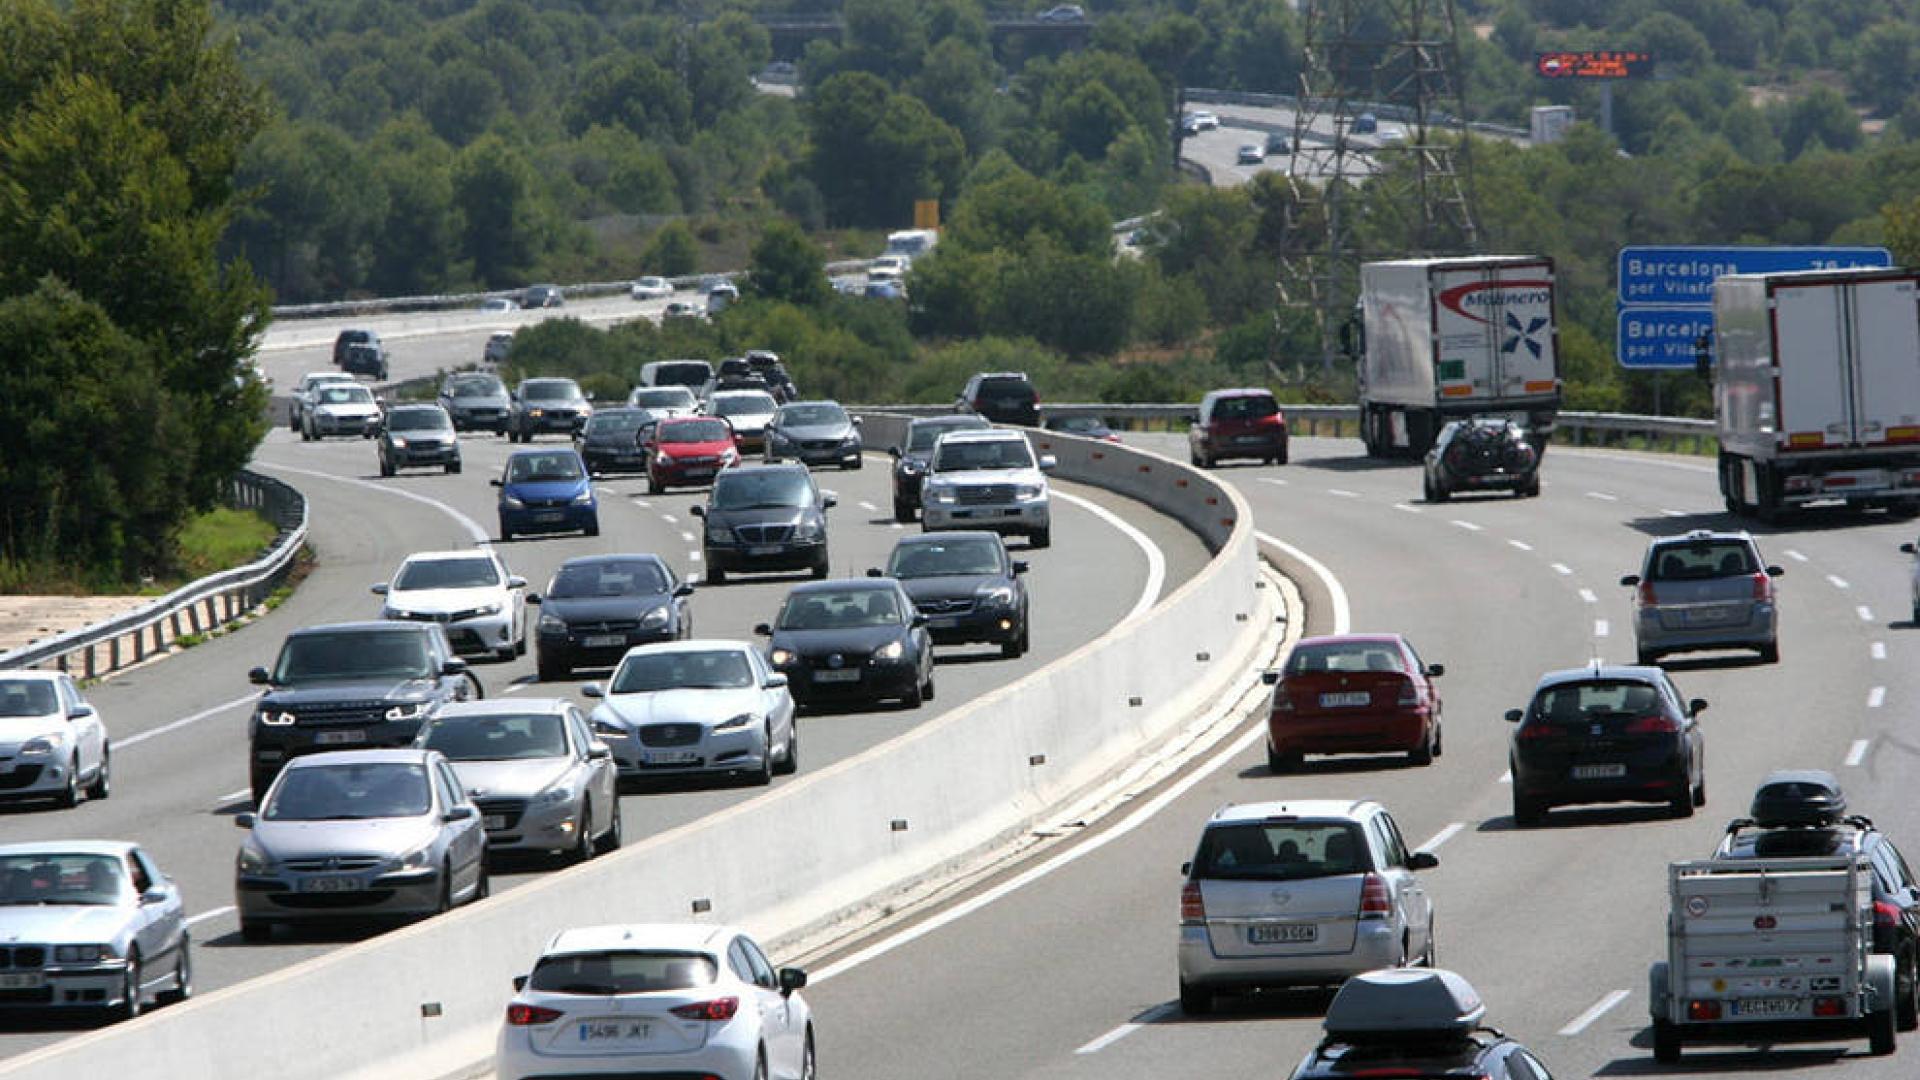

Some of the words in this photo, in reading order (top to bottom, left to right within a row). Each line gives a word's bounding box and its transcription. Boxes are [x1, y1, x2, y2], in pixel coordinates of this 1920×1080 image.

[1628, 259, 1737, 276] Barcelona
[1629, 284, 1655, 296] por
[1664, 281, 1714, 294] Vilafr
